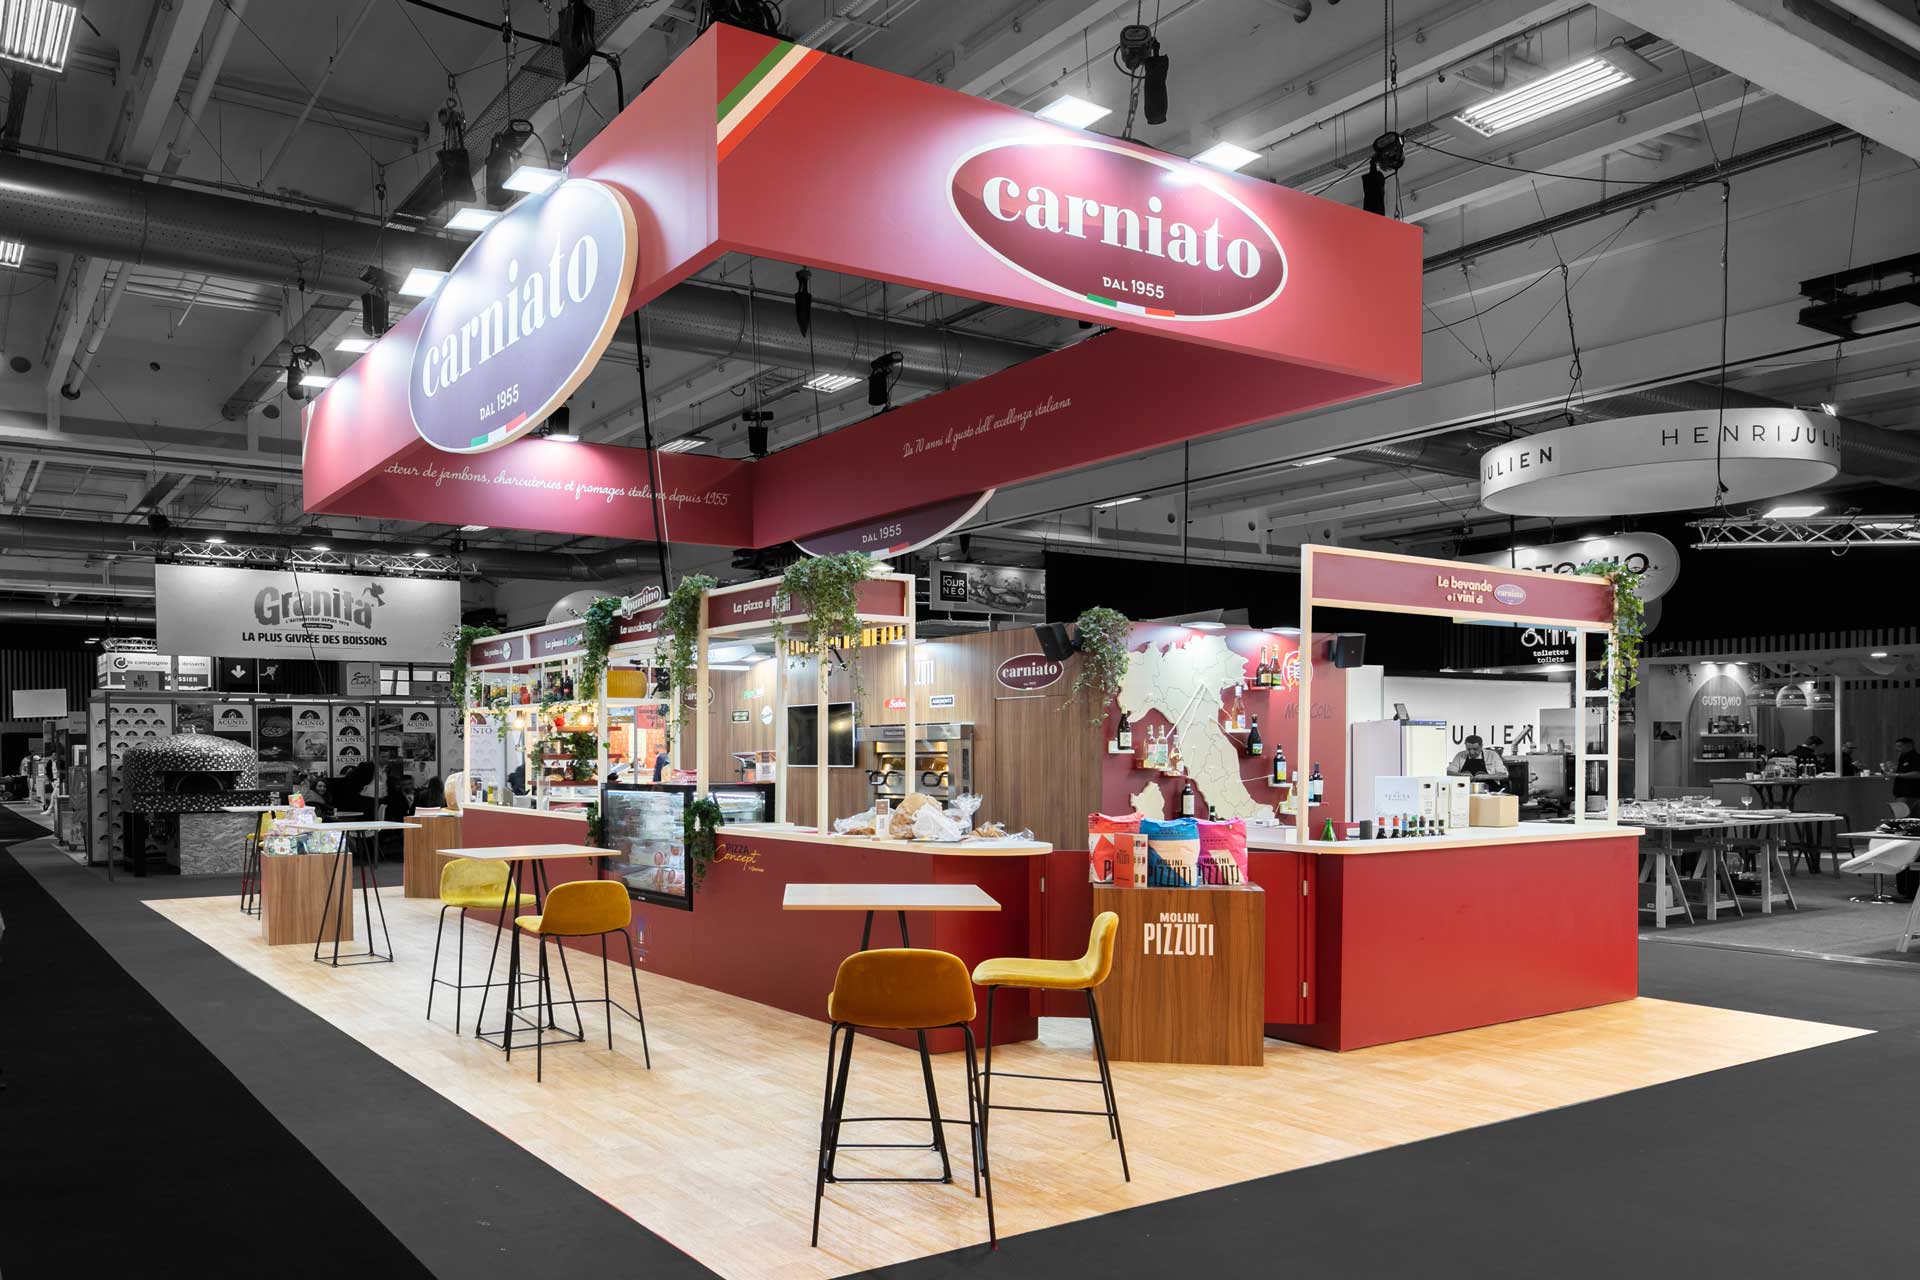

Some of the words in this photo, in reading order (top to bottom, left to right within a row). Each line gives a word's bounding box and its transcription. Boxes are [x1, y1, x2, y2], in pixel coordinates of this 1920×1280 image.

[982, 176, 1261, 279] carniato
[1102, 276, 1128, 291] DAL
[1131, 279, 1165, 299] 1955
[422, 234, 598, 398] carniato
[479, 403, 495, 421] DAL
[496, 383, 520, 413] 1955
[915, 438, 925, 453] 70
[925, 436, 943, 450] anni
[944, 427, 954, 444] il
[952, 427, 975, 451] gusto
[1035, 395, 1073, 417] italiana
[422, 462, 437, 477] de
[436, 466, 491, 487] jambons,
[493, 469, 562, 490] charcuteries
[564, 480, 575, 491] et
[575, 483, 625, 503] fromages
[669, 487, 701, 509] depuis
[704, 491, 731, 506] 1955
[862, 532, 879, 544] DAL
[879, 523, 903, 539] 1955
[1437, 576, 1450, 588] Le
[1451, 576, 1493, 592] bevande
[254, 586, 373, 629] Granita
[621, 590, 659, 616] Spuntino
[733, 603, 742, 613] La
[743, 600, 764, 614] pizza
[1457, 590, 1475, 603] vini
[242, 632, 255, 642] LA
[258, 632, 282, 643] PLUS
[285, 631, 320, 644] GIVRÉE
[322, 635, 340, 644] DES
[342, 636, 387, 646] BOISSONS
[1533, 649, 1569, 657] toilettes
[1537, 656, 1565, 664] toilets
[1002, 662, 1058, 679] carniato
[713, 844, 762, 871] Concept
[1197, 865, 1239, 885] PIZZUTI
[1160, 912, 1199, 923] MOLINI
[1144, 923, 1214, 957] PIZZUTI
